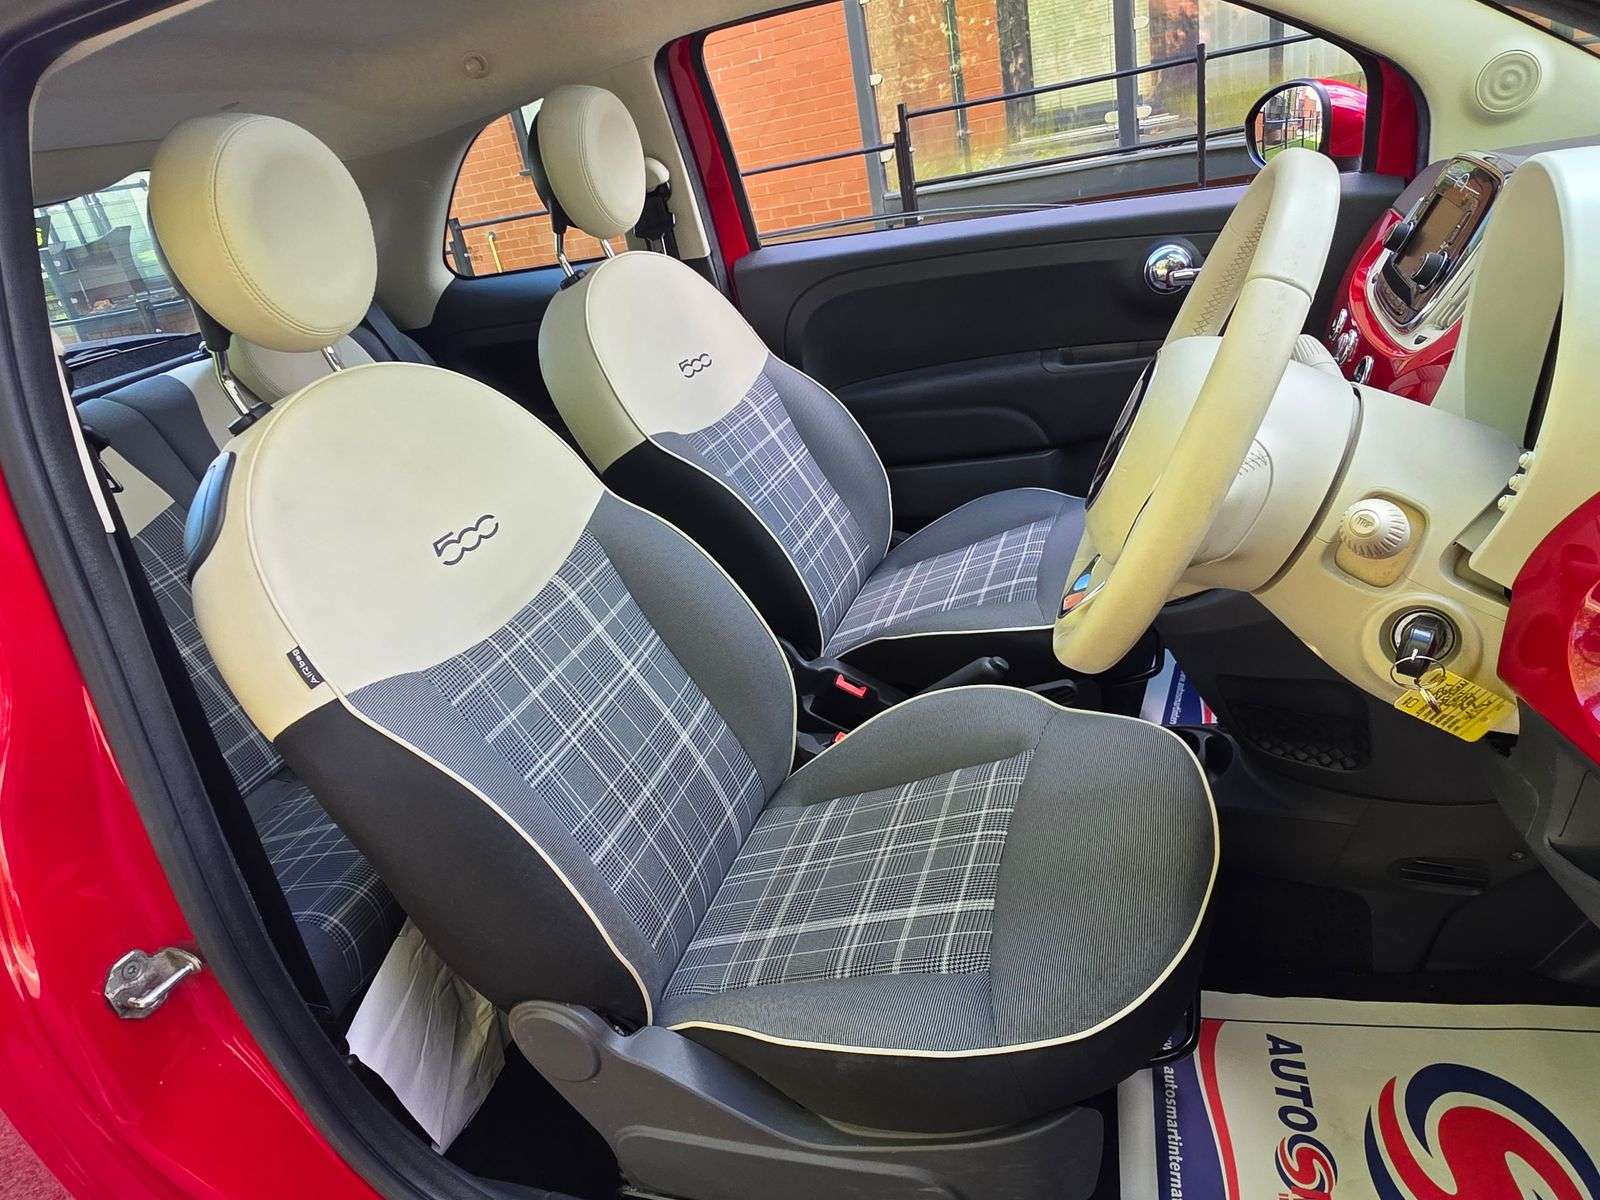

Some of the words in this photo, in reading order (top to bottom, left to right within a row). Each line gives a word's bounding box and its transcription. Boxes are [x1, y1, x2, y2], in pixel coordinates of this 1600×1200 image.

[679, 353, 712, 378] 500
[433, 514, 499, 566] 500
[1266, 1033, 1338, 1200] AUTOS
